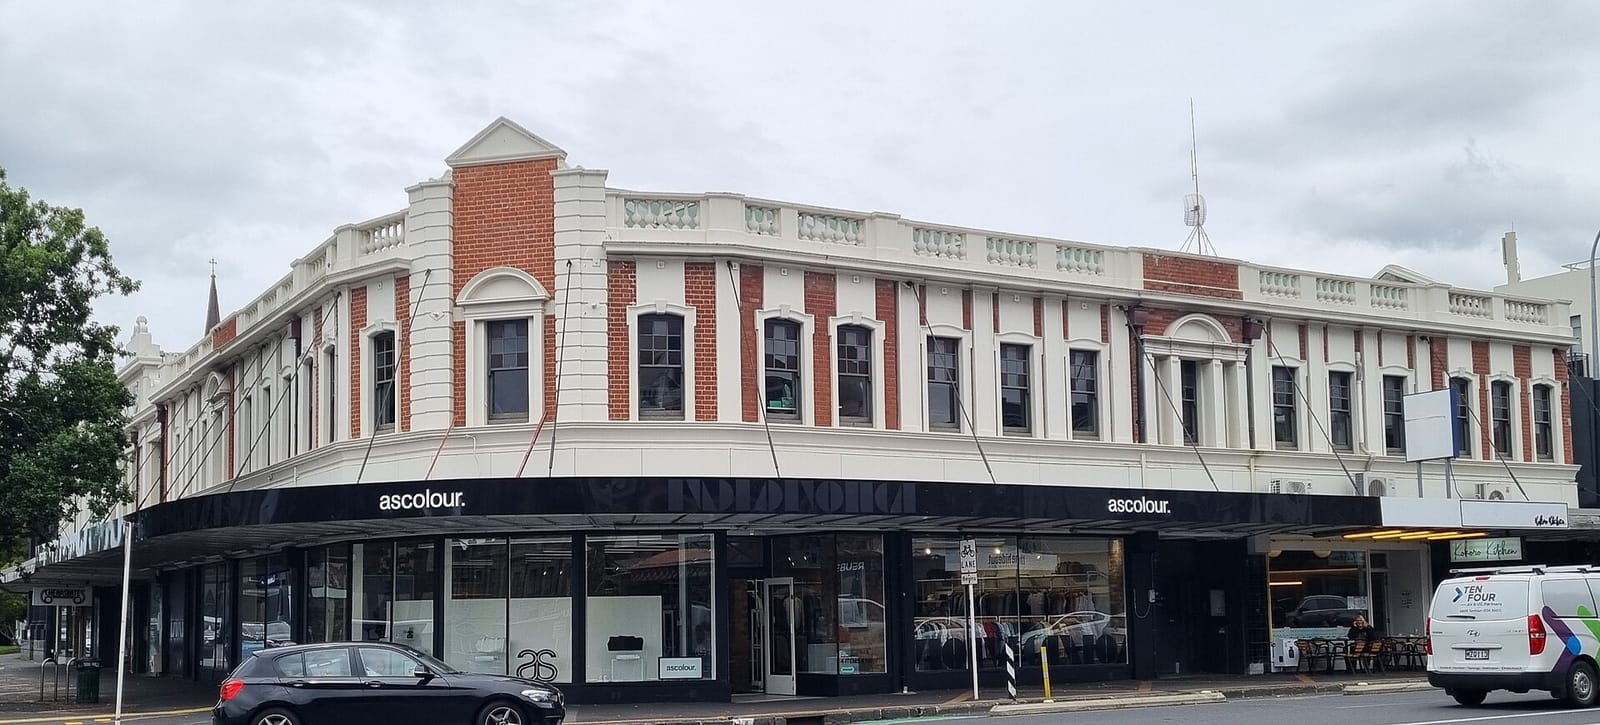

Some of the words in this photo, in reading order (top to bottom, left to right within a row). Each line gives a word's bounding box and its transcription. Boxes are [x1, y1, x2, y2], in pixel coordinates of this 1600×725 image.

[379, 488, 466, 510] ascolour.
[1107, 496, 1171, 514] ascolour.
[1454, 540, 1482, 560] Kokoro
[1487, 540, 1518, 560] Kitchen
[962, 560, 976, 569] LANE
[1464, 585, 1483, 594] TEN
[1467, 593, 1496, 602] FOUR
[666, 663, 697, 672] ascolour.
